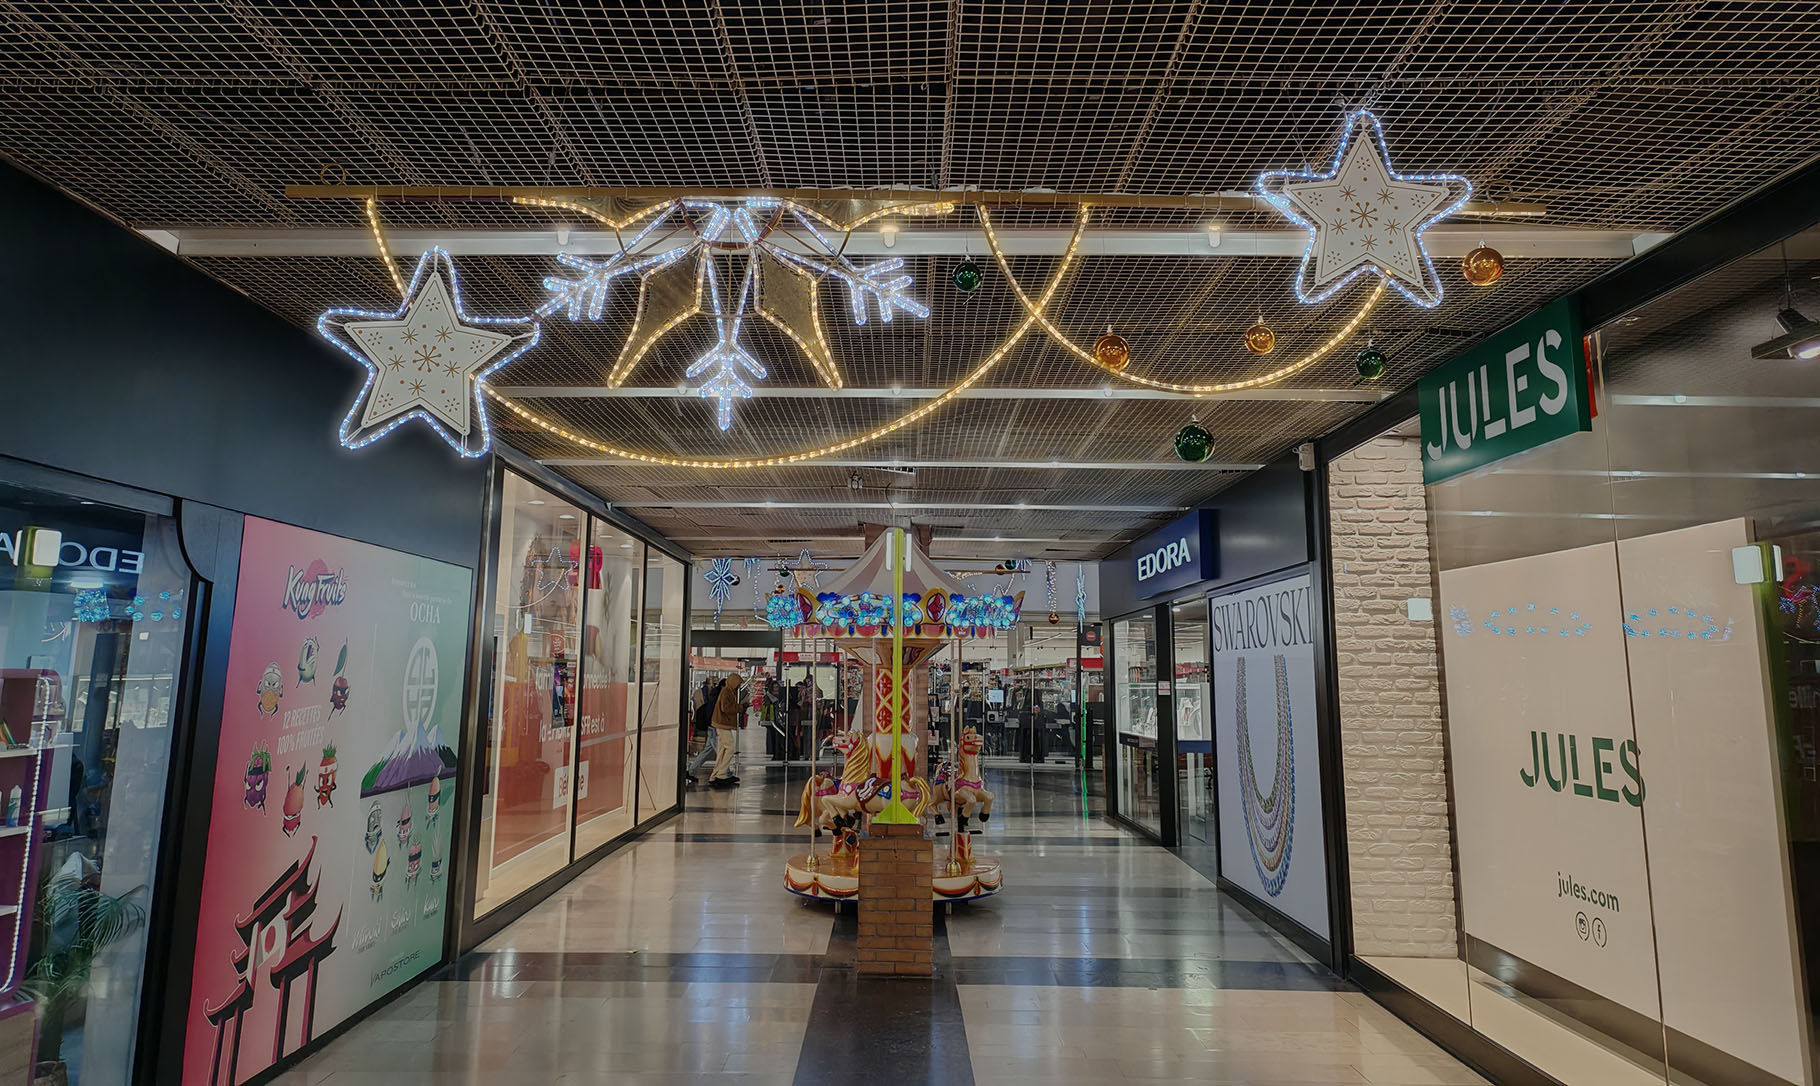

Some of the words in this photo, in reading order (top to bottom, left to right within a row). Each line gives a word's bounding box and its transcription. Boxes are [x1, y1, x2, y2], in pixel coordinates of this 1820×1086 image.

[1427, 329, 1568, 461] JULES
[1137, 537, 1191, 582] EDORA
[315, 567, 348, 606] Fruits
[410, 601, 441, 624] OCHA
[1213, 586, 1313, 652] SWAROVSKI
[1519, 731, 1646, 808] JULES
[1558, 871, 1620, 913] jules.com
[369, 950, 421, 989] VAPOSTORE
